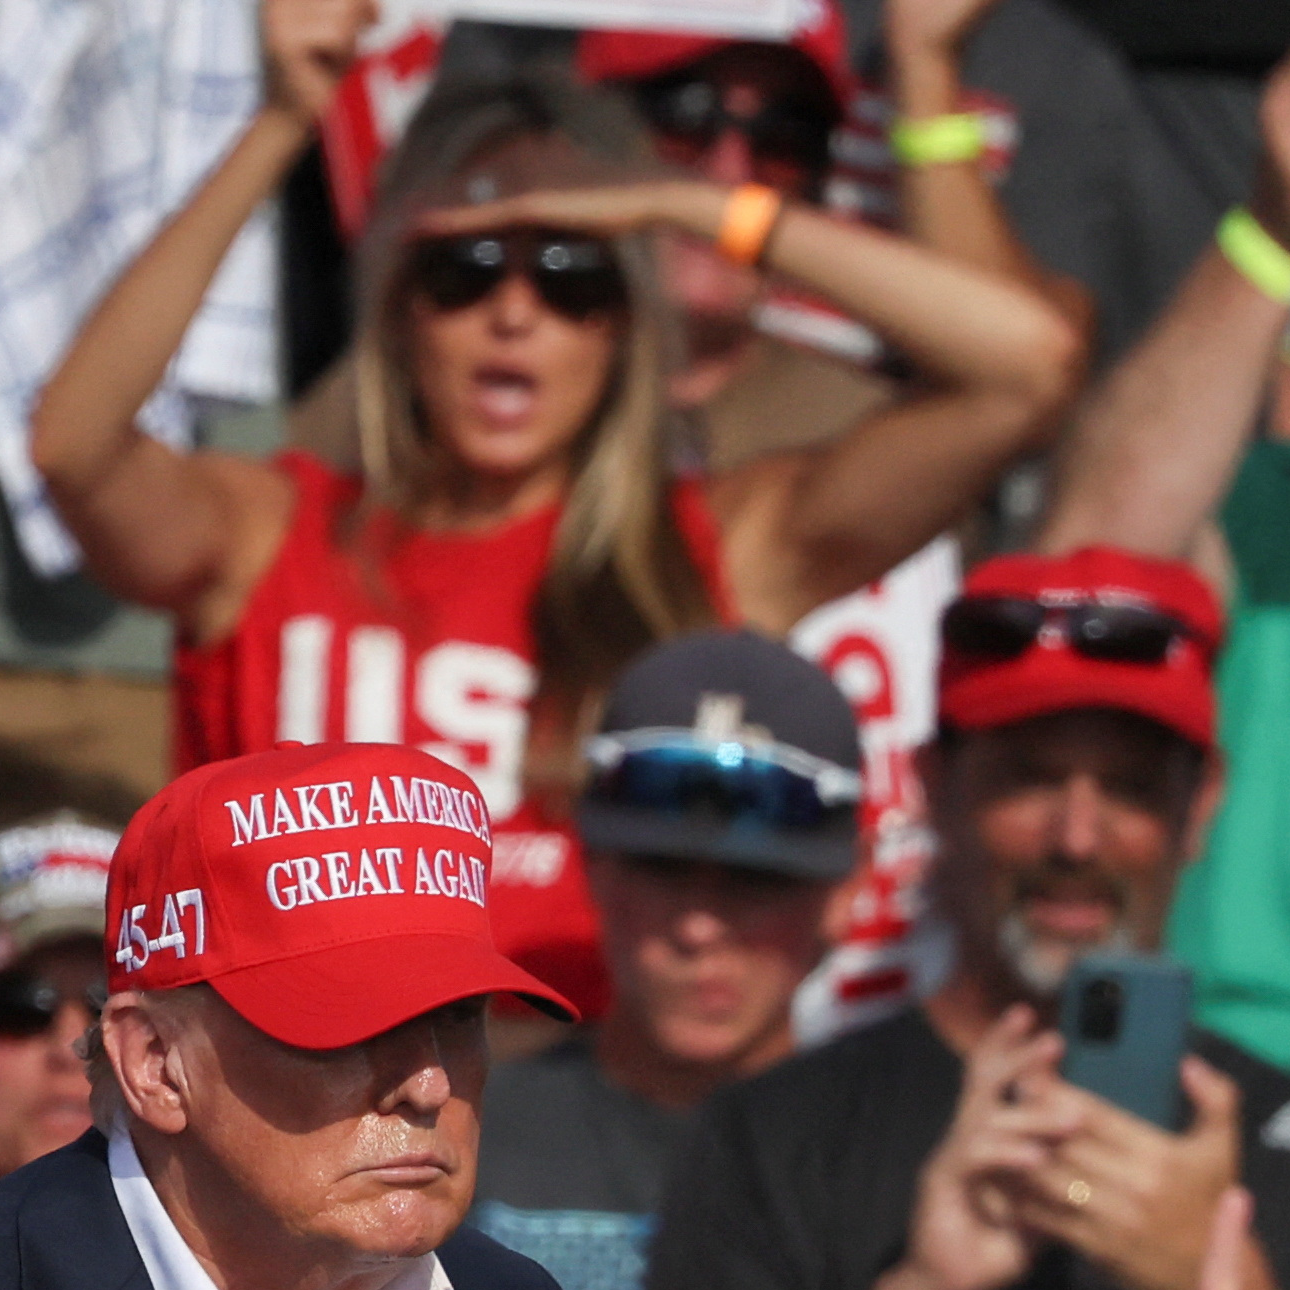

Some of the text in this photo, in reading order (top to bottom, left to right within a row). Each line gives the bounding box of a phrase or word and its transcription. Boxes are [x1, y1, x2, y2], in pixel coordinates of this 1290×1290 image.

[224, 776, 491, 848] MAKE AMERICA
[266, 847, 404, 911] GREAT
[115, 888, 206, 973] 45-47
